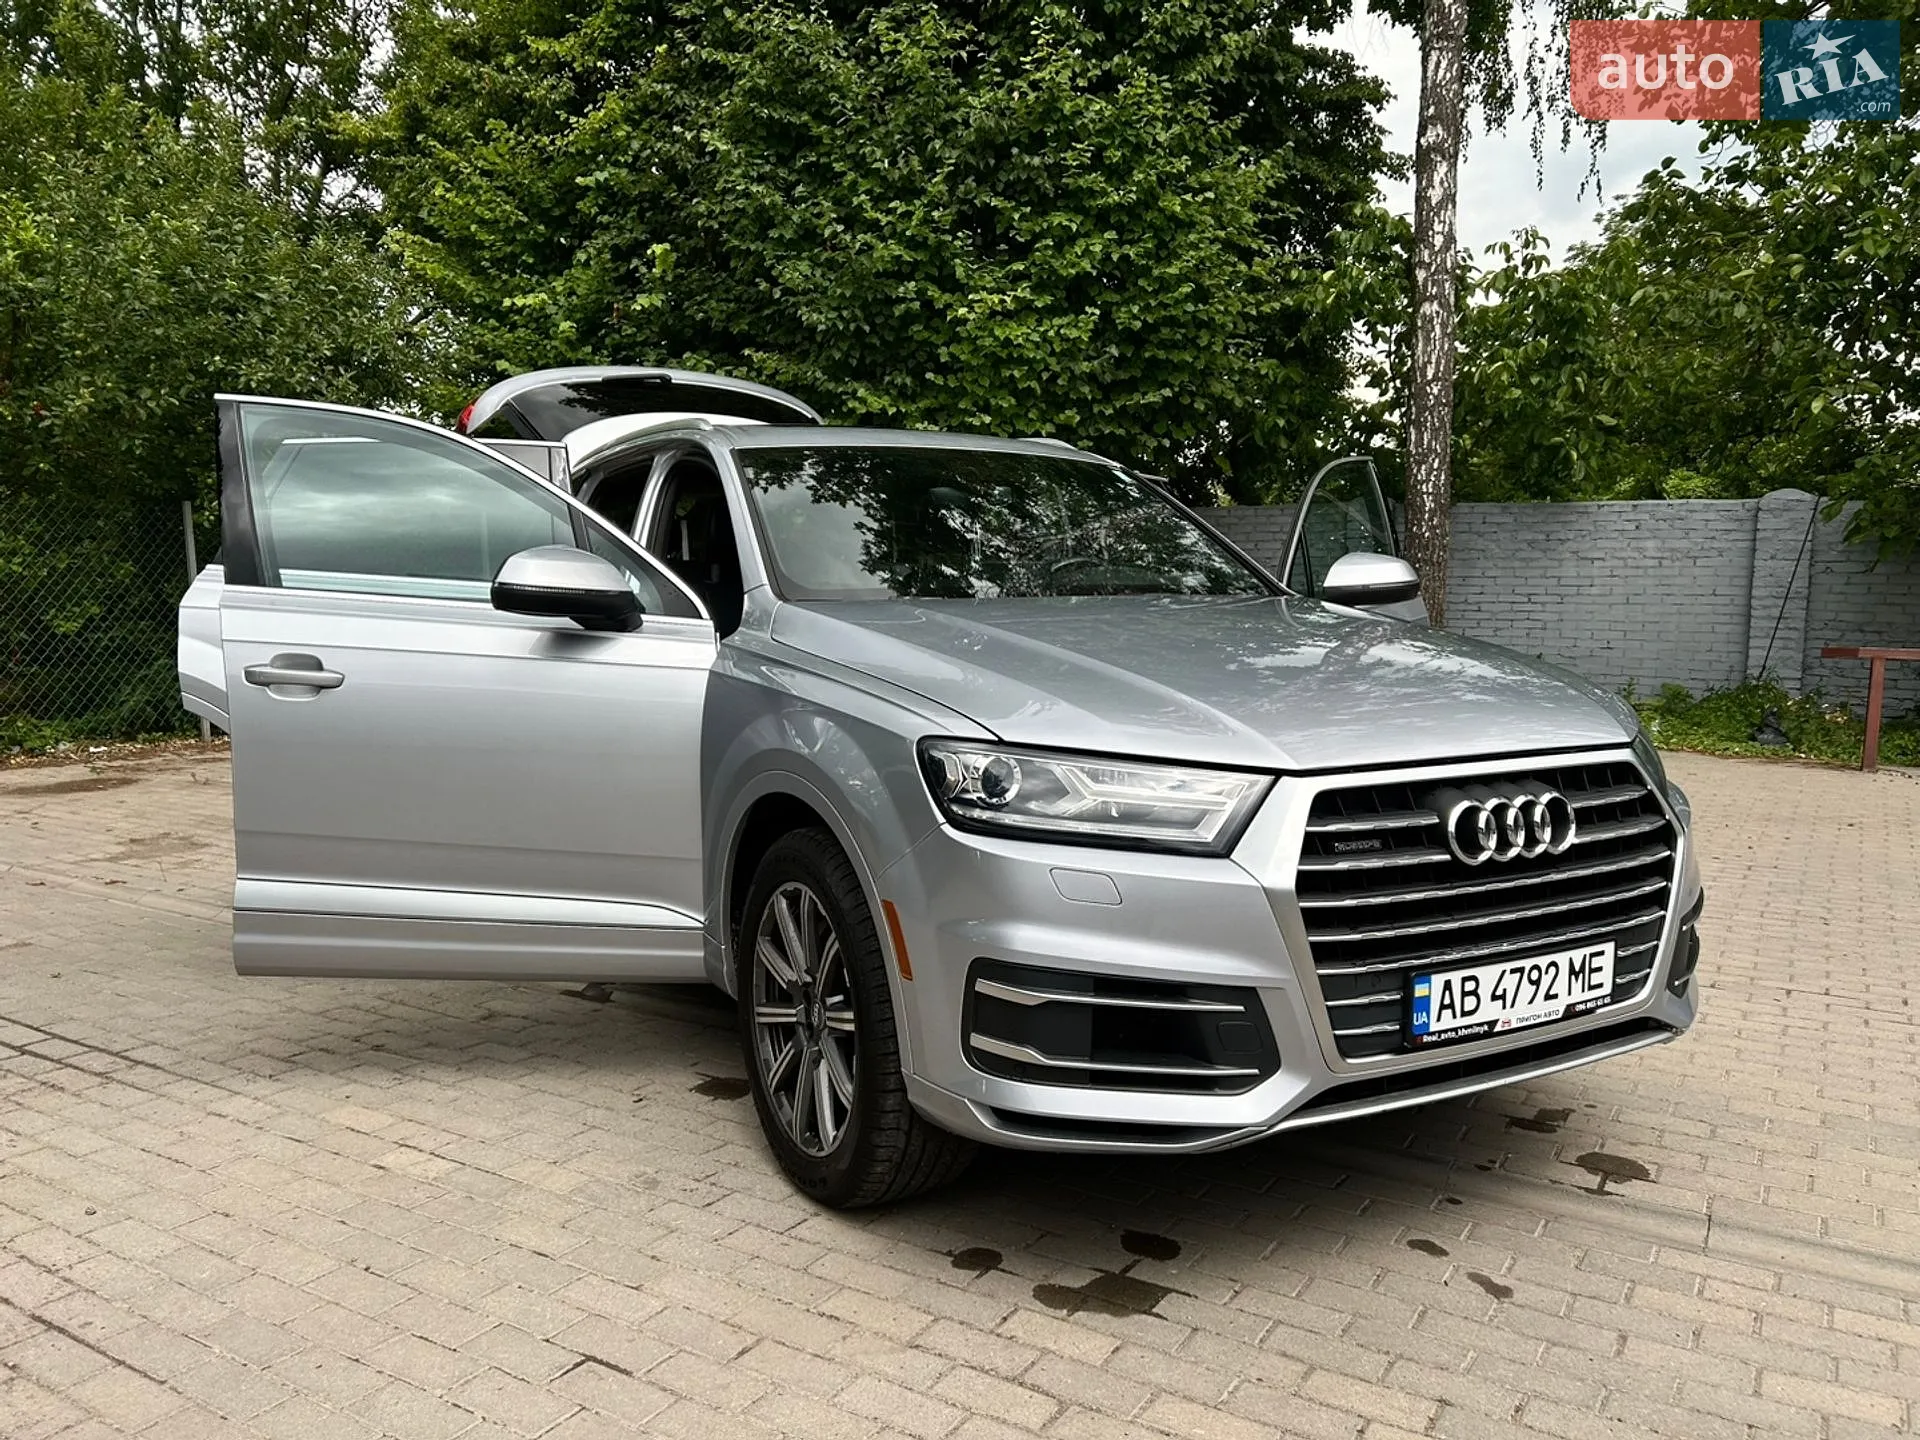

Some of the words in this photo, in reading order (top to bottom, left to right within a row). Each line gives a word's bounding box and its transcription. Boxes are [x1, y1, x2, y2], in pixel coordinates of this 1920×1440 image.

[1435, 974, 1482, 1023] AB
[1490, 960, 1560, 1011] 4792
[1567, 949, 1606, 997] ME
[1413, 1012, 1428, 1026] UA
